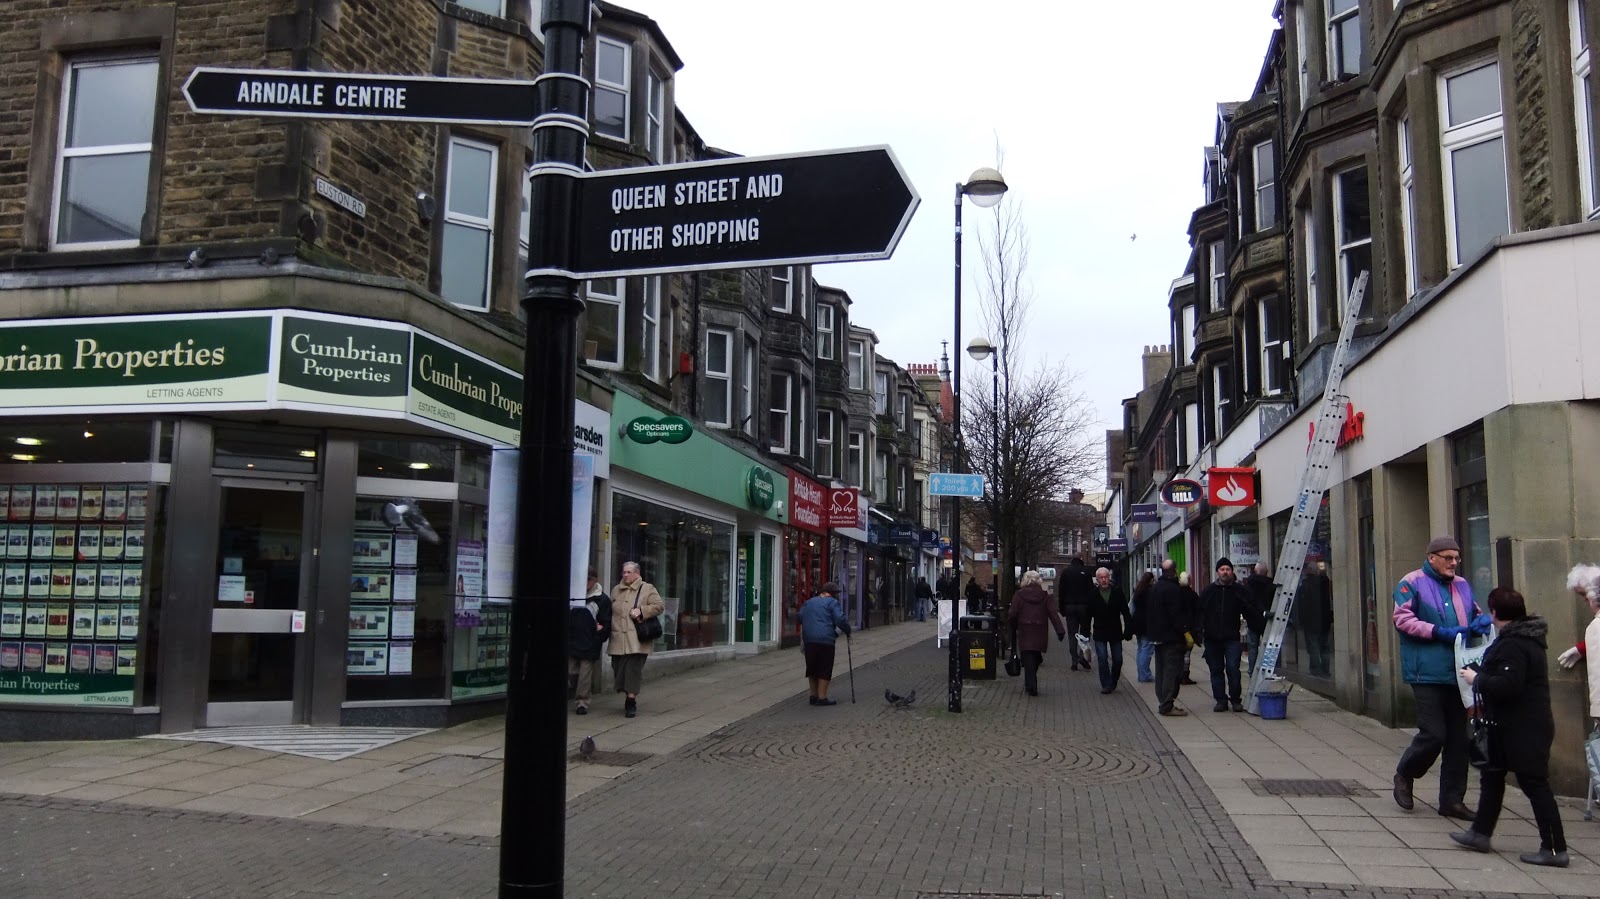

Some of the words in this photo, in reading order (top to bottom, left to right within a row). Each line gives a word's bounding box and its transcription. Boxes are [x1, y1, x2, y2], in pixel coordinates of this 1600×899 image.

[237, 81, 325, 106] ARNDALE
[335, 85, 408, 110] CENTRE
[318, 181, 350, 207] EUSTON
[352, 200, 364, 215] RD
[611, 184, 667, 214] QUEEN
[674, 177, 741, 206] STREET
[745, 173, 783, 199] AND
[610, 226, 664, 253] OTHER
[671, 217, 760, 248] SHOPPING
[72, 338, 225, 377] Properties
[290, 333, 404, 365] Cumbrian
[302, 357, 391, 383] Properties
[146, 388, 184, 399] LETTING
[186, 387, 224, 398] AGENTS
[419, 354, 487, 403] Cumbrian
[490, 381, 523, 420] Prope
[418, 401, 437, 415] ESTATE
[437, 407, 457, 421] AGENTS
[575, 424, 603, 448] arsden
[633, 421, 684, 433] Specsavers
[794, 476, 809, 501] British
[943, 477, 967, 485] Toilets
[1172, 491, 1195, 503] HILL
[794, 500, 820, 527] Foundation
[21, 675, 80, 693] Properties
[83, 695, 106, 703] LETTING
